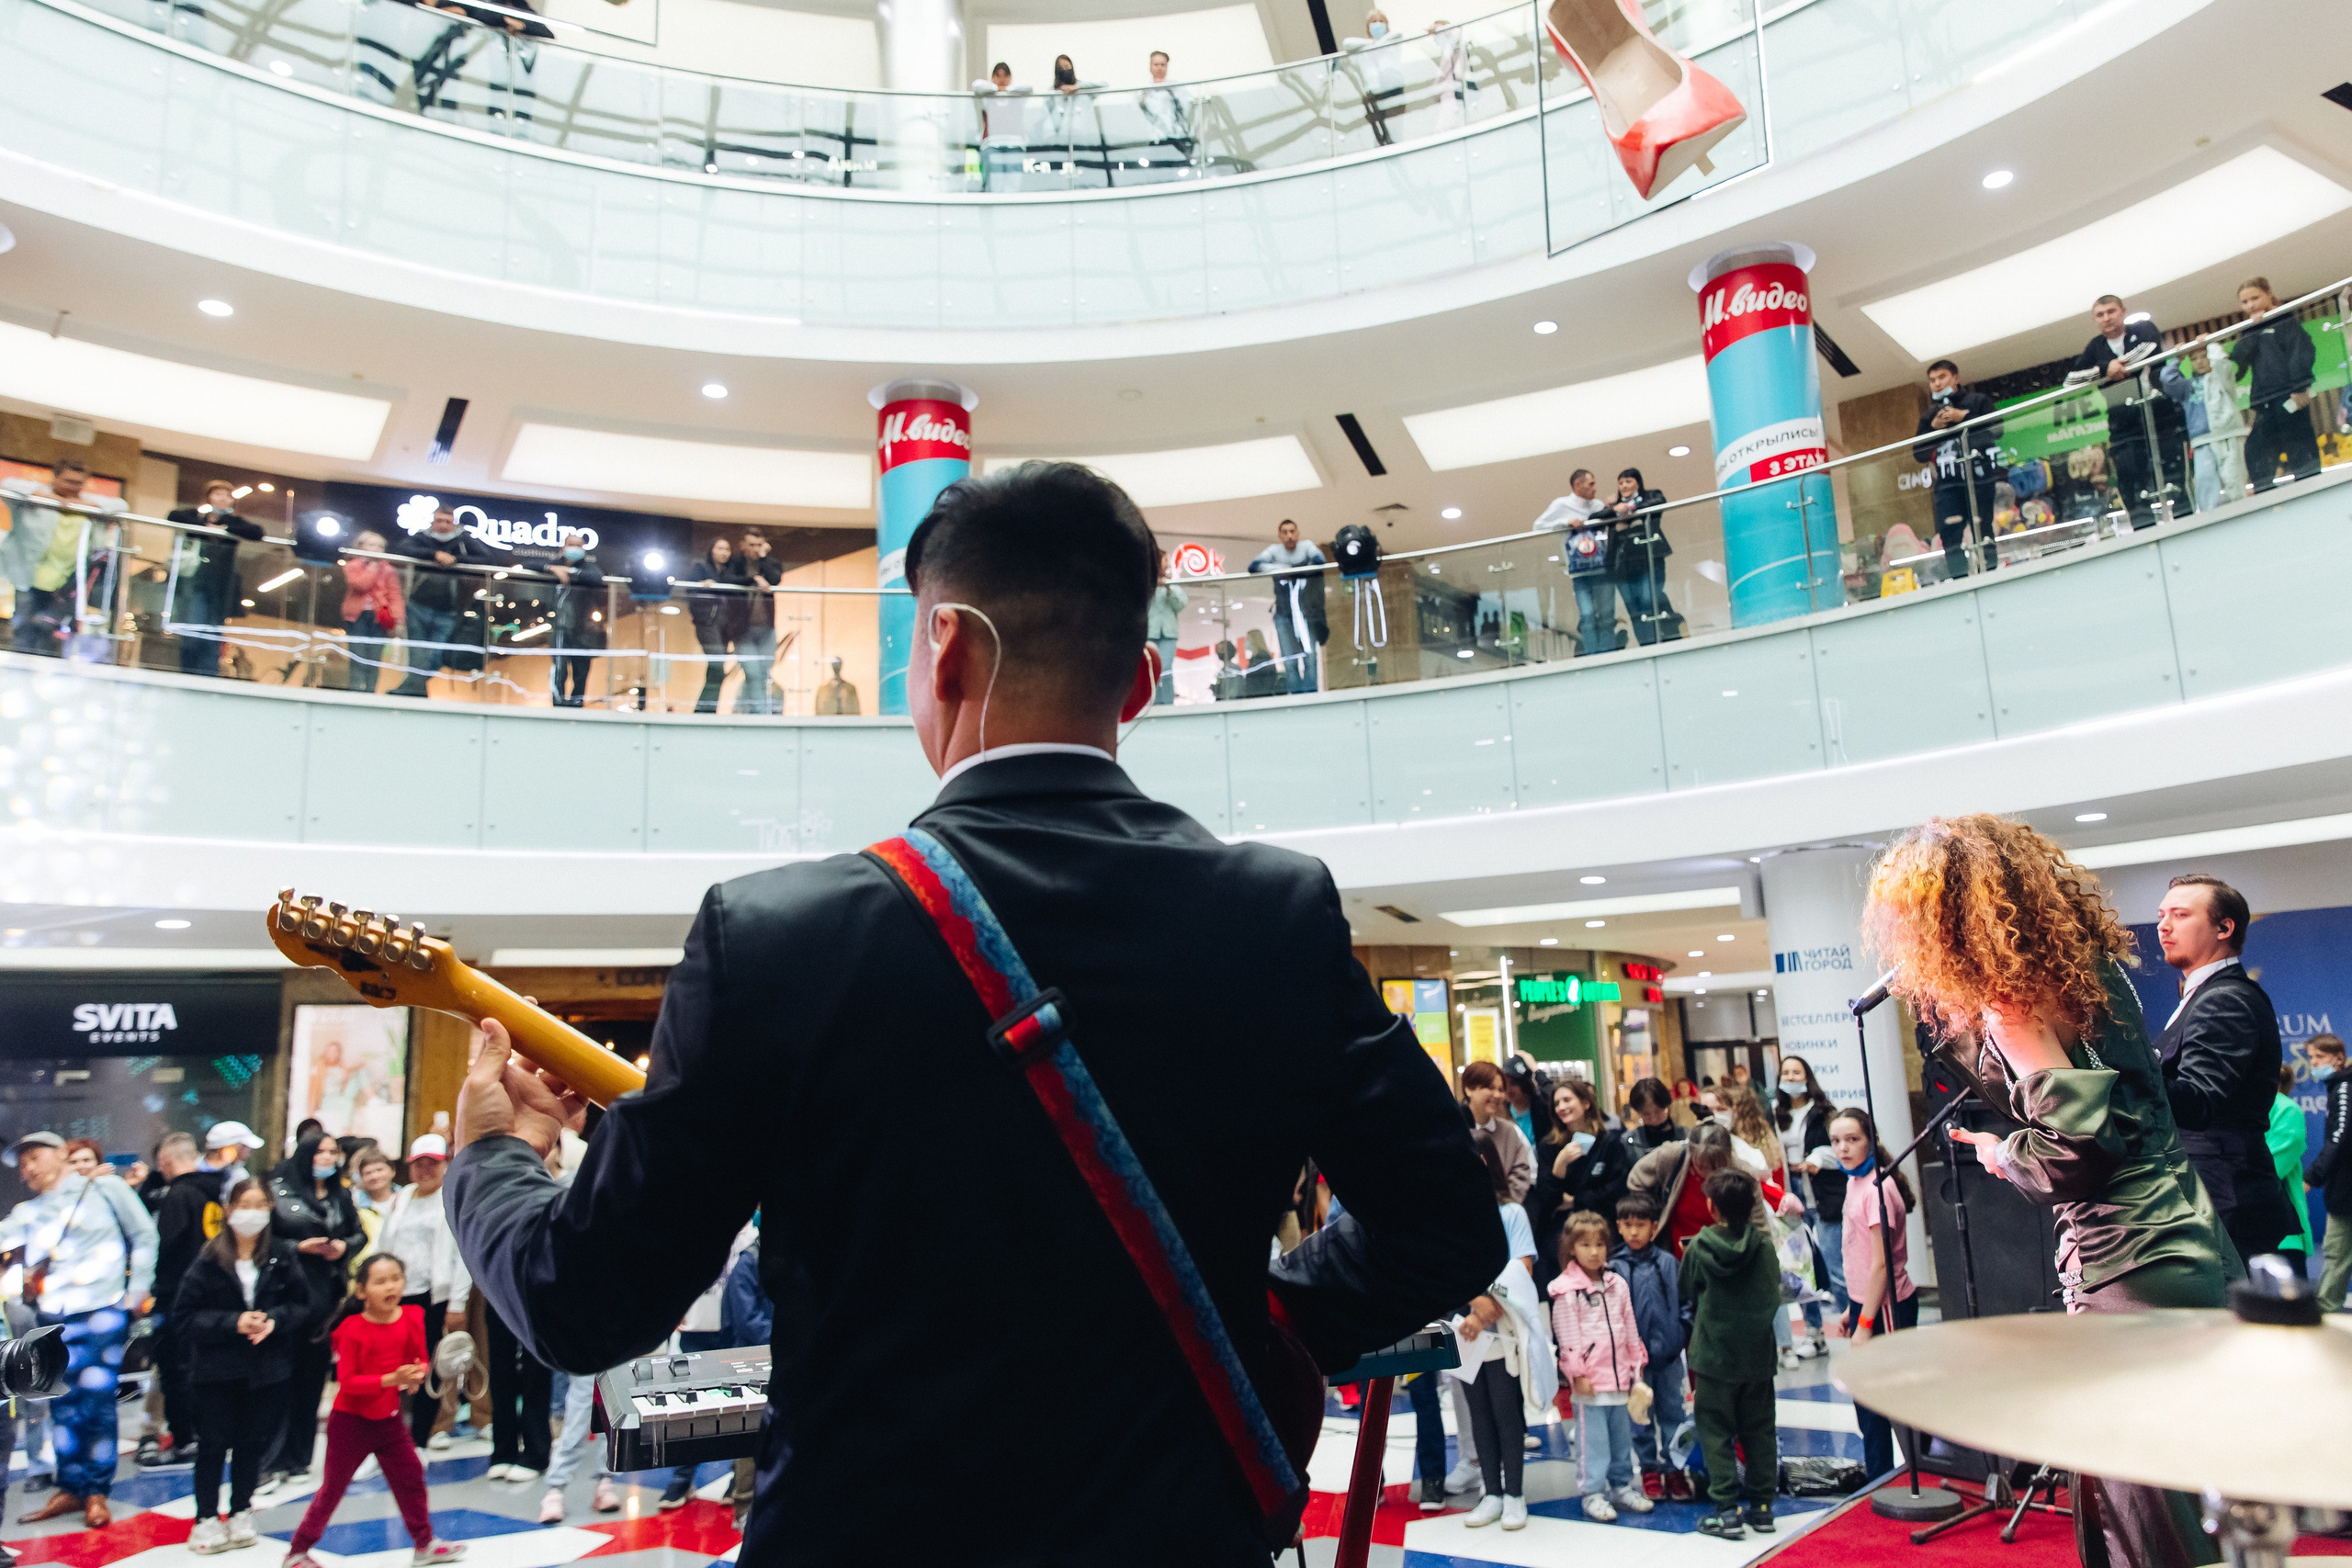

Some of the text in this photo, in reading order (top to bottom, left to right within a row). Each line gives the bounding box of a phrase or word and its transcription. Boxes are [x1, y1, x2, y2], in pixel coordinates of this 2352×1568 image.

[453, 505, 599, 551] Quadro
[1804, 943, 1850, 958] ЧИТАЙ
[1804, 958, 1853, 971] ГОРОД
[73, 1003, 178, 1031] SVITA
[89, 1031, 160, 1043] EVENTS
